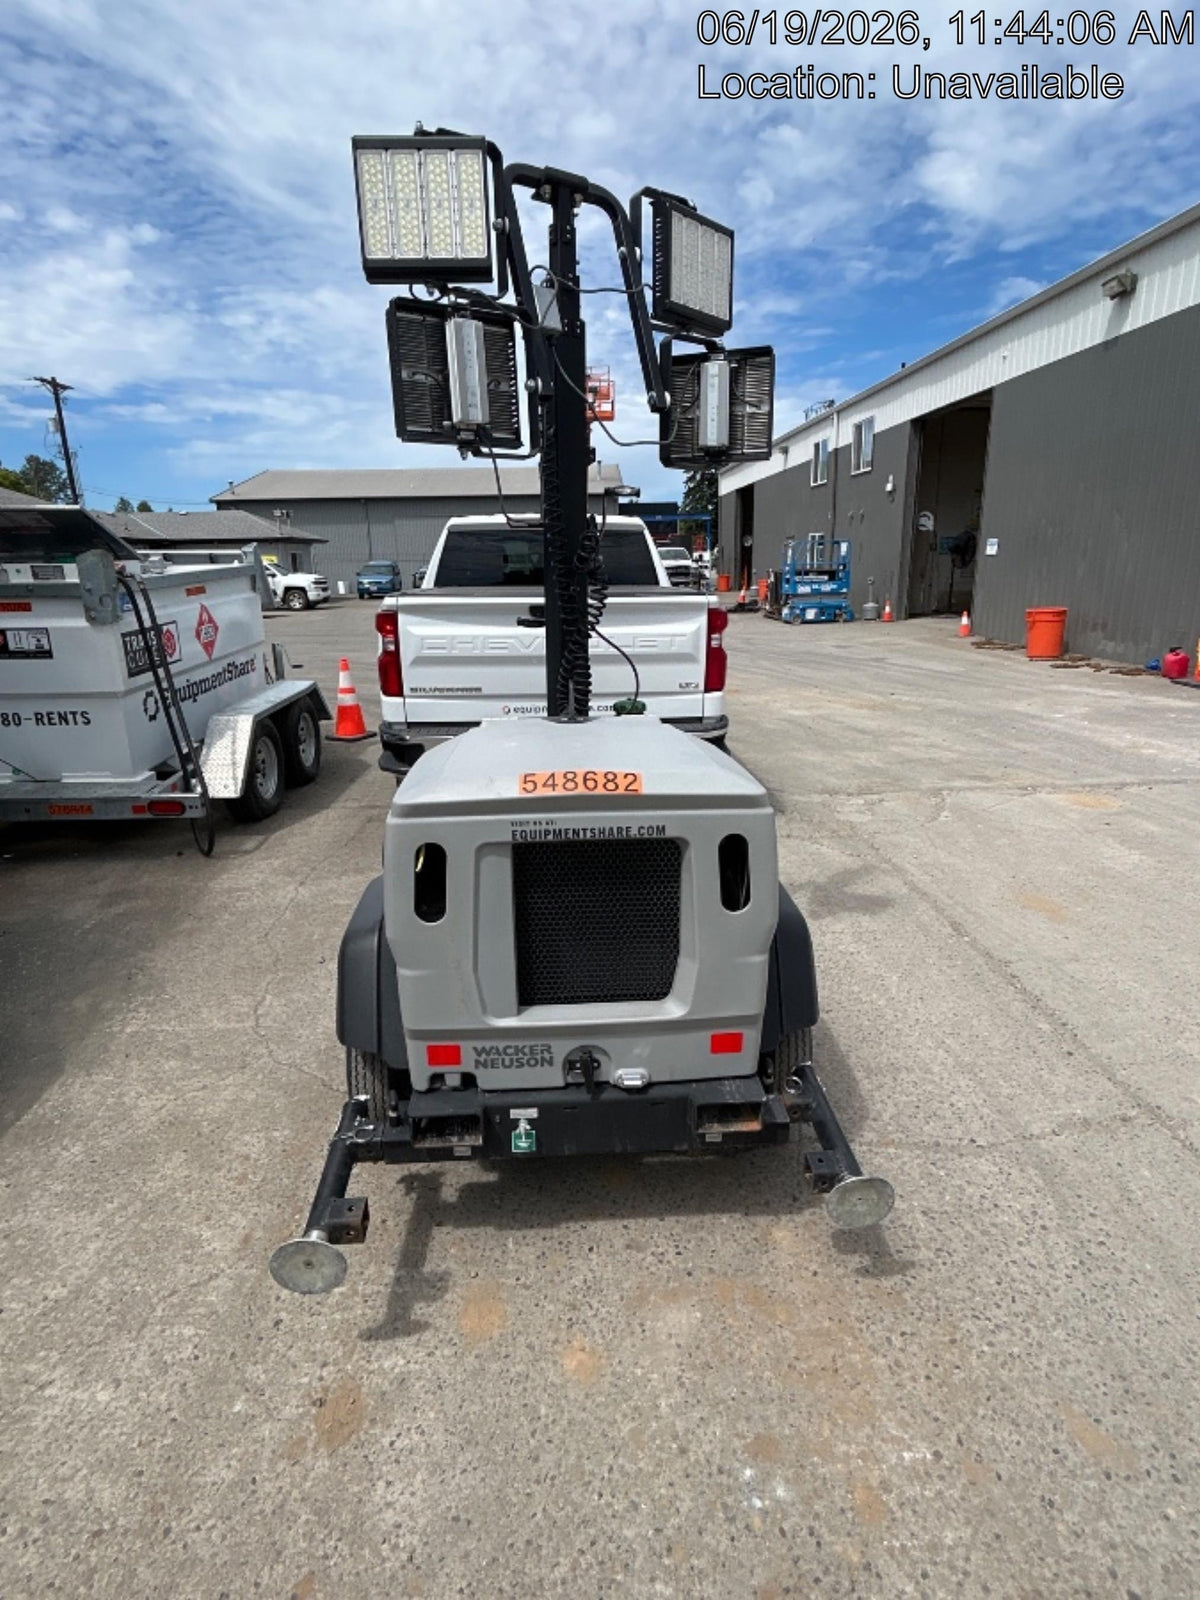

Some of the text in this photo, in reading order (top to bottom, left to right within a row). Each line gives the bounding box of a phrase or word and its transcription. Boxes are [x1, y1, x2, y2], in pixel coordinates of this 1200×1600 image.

[419, 634, 688, 654] CHEVLET
[521, 770, 639, 794] 548682
[511, 824, 667, 842] EQUIPMENTSHARE.COM
[472, 1043, 554, 1057] WACKER
[474, 1055, 554, 1070] NEUSON
